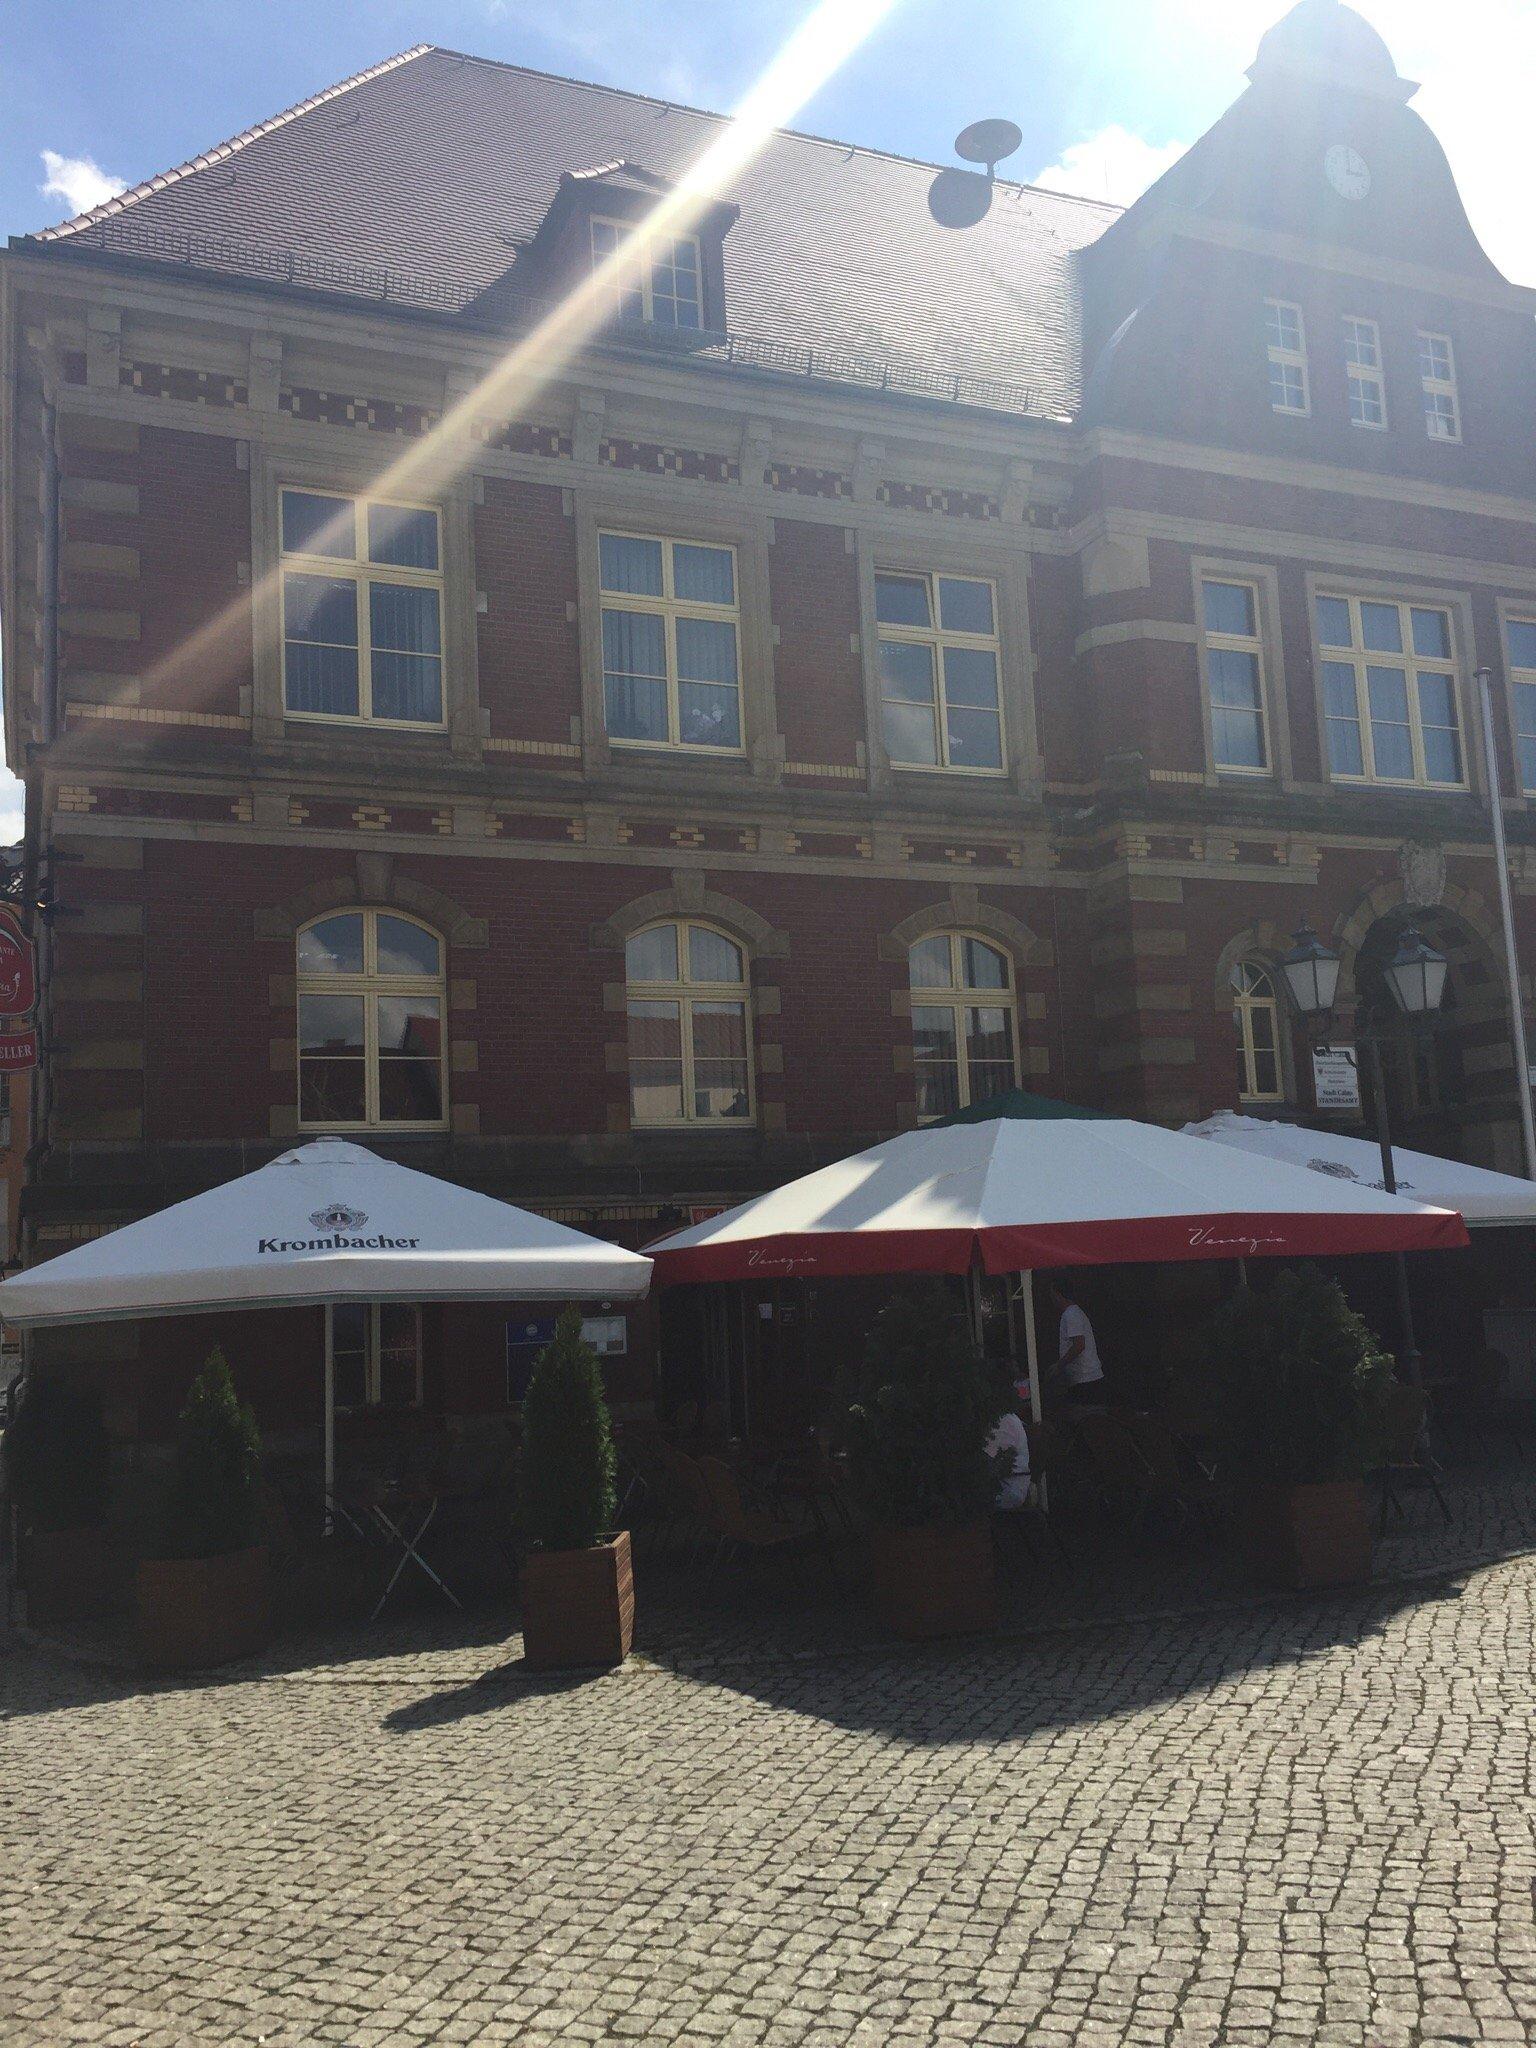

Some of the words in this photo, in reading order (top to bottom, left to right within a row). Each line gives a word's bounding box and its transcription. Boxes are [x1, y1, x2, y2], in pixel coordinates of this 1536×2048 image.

[257, 1234, 420, 1253] Krombacher
[1187, 1226, 1287, 1253] Venezia
[748, 1248, 817, 1272] Venezia
